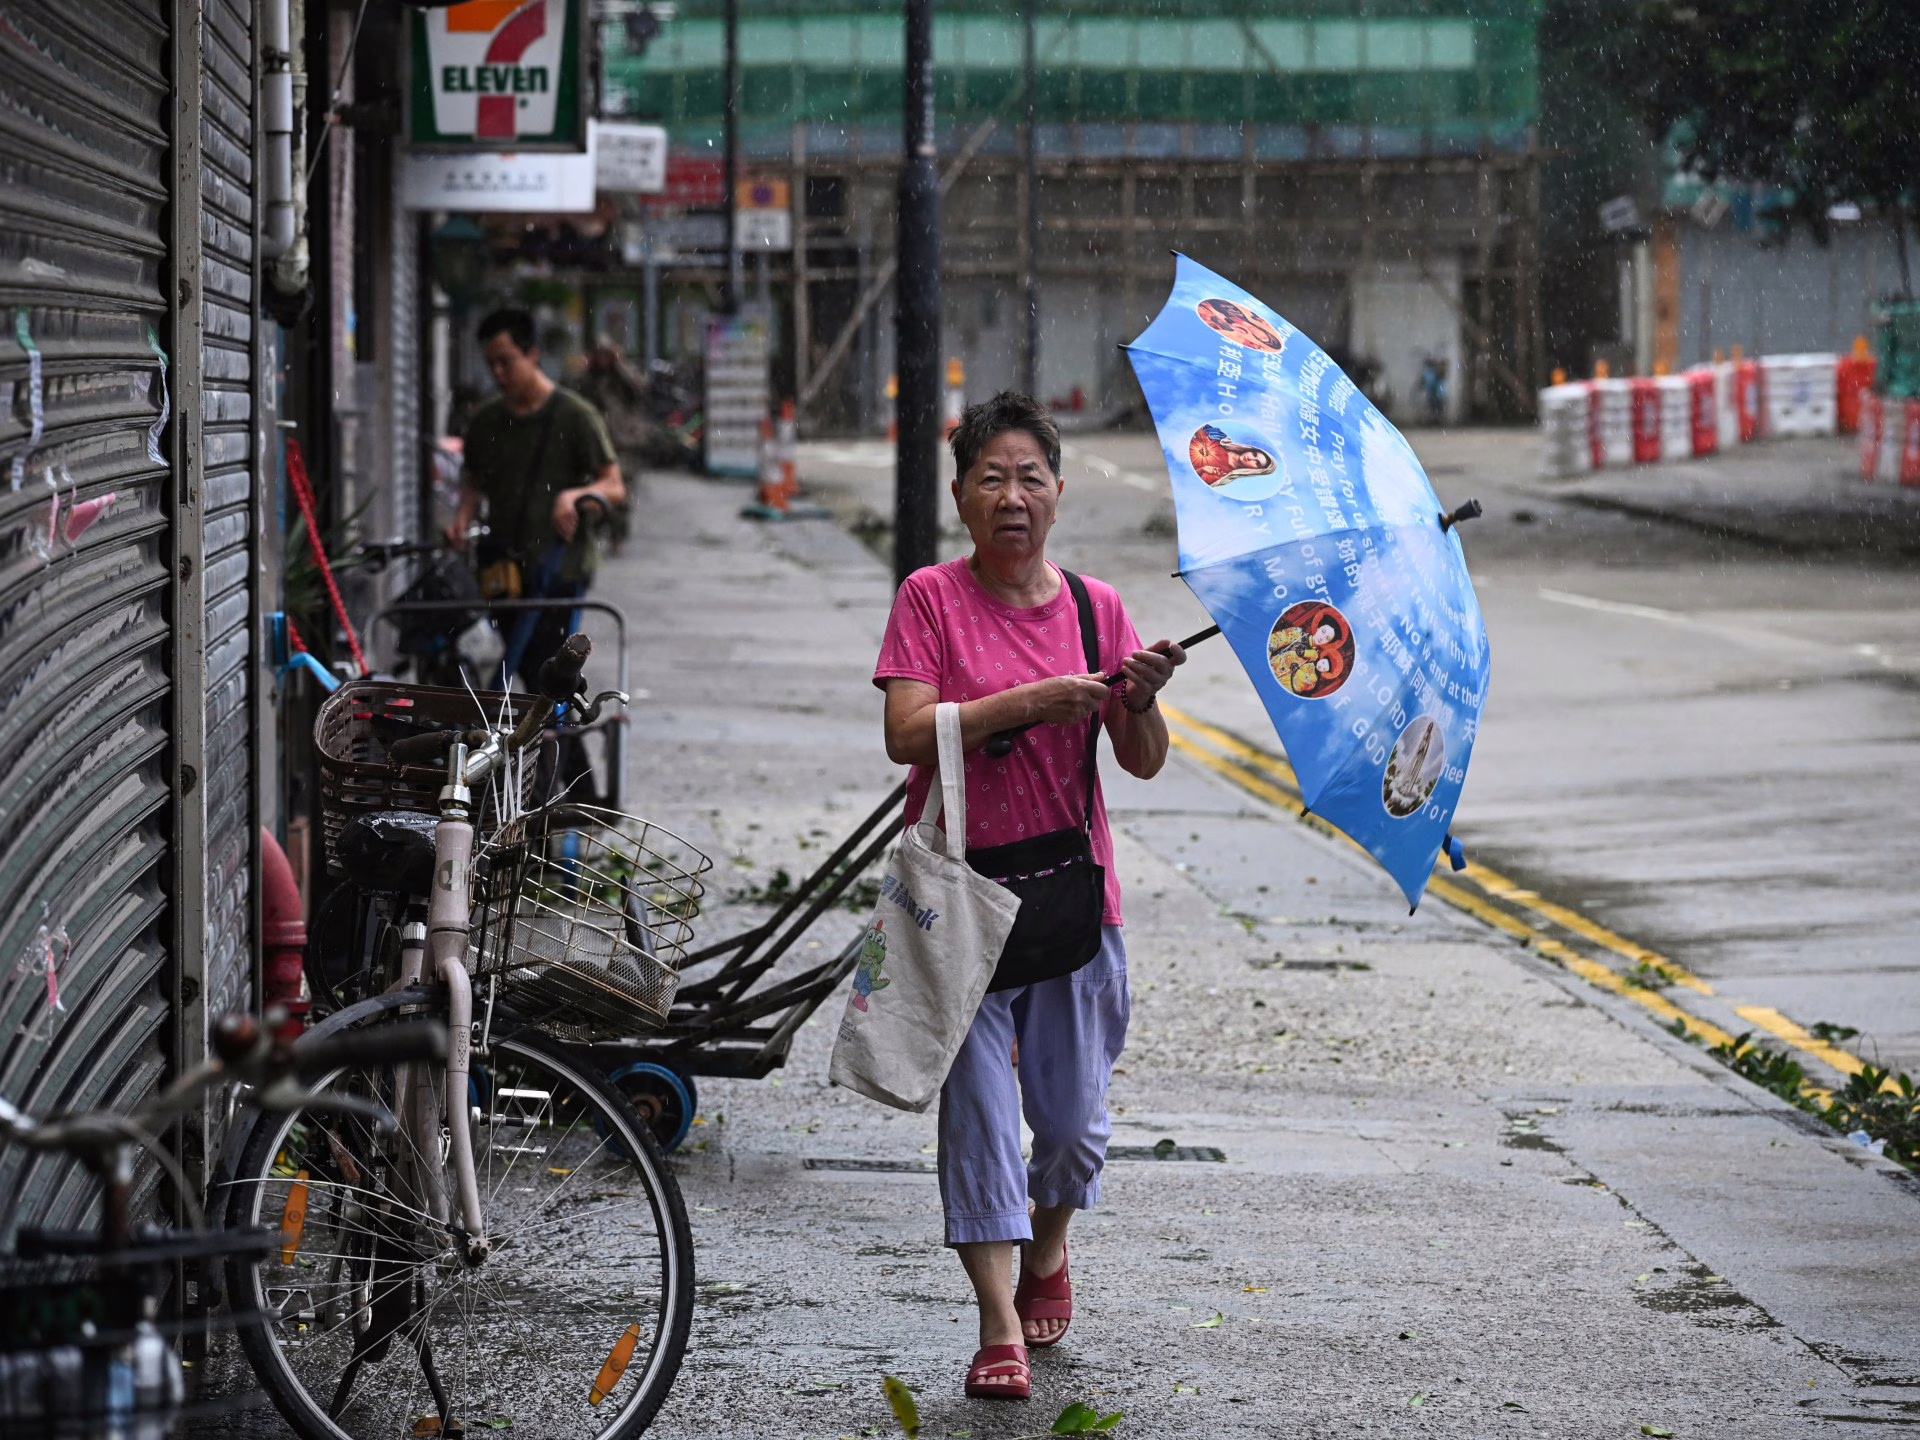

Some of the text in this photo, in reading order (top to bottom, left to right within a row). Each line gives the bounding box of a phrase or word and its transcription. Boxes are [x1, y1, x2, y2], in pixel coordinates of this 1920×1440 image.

[1300, 543, 1324, 567] of
[1329, 429, 1347, 476] Pray
[1338, 478, 1358, 508] for
[1352, 511, 1369, 533] us
[1428, 658, 1449, 688] and
[1447, 681, 1460, 700] at
[1460, 685, 1480, 710] the
[1438, 627, 1450, 649] of
[1449, 637, 1467, 671] thy
[1365, 671, 1407, 731] LORD
[1351, 717, 1387, 766] GOD
